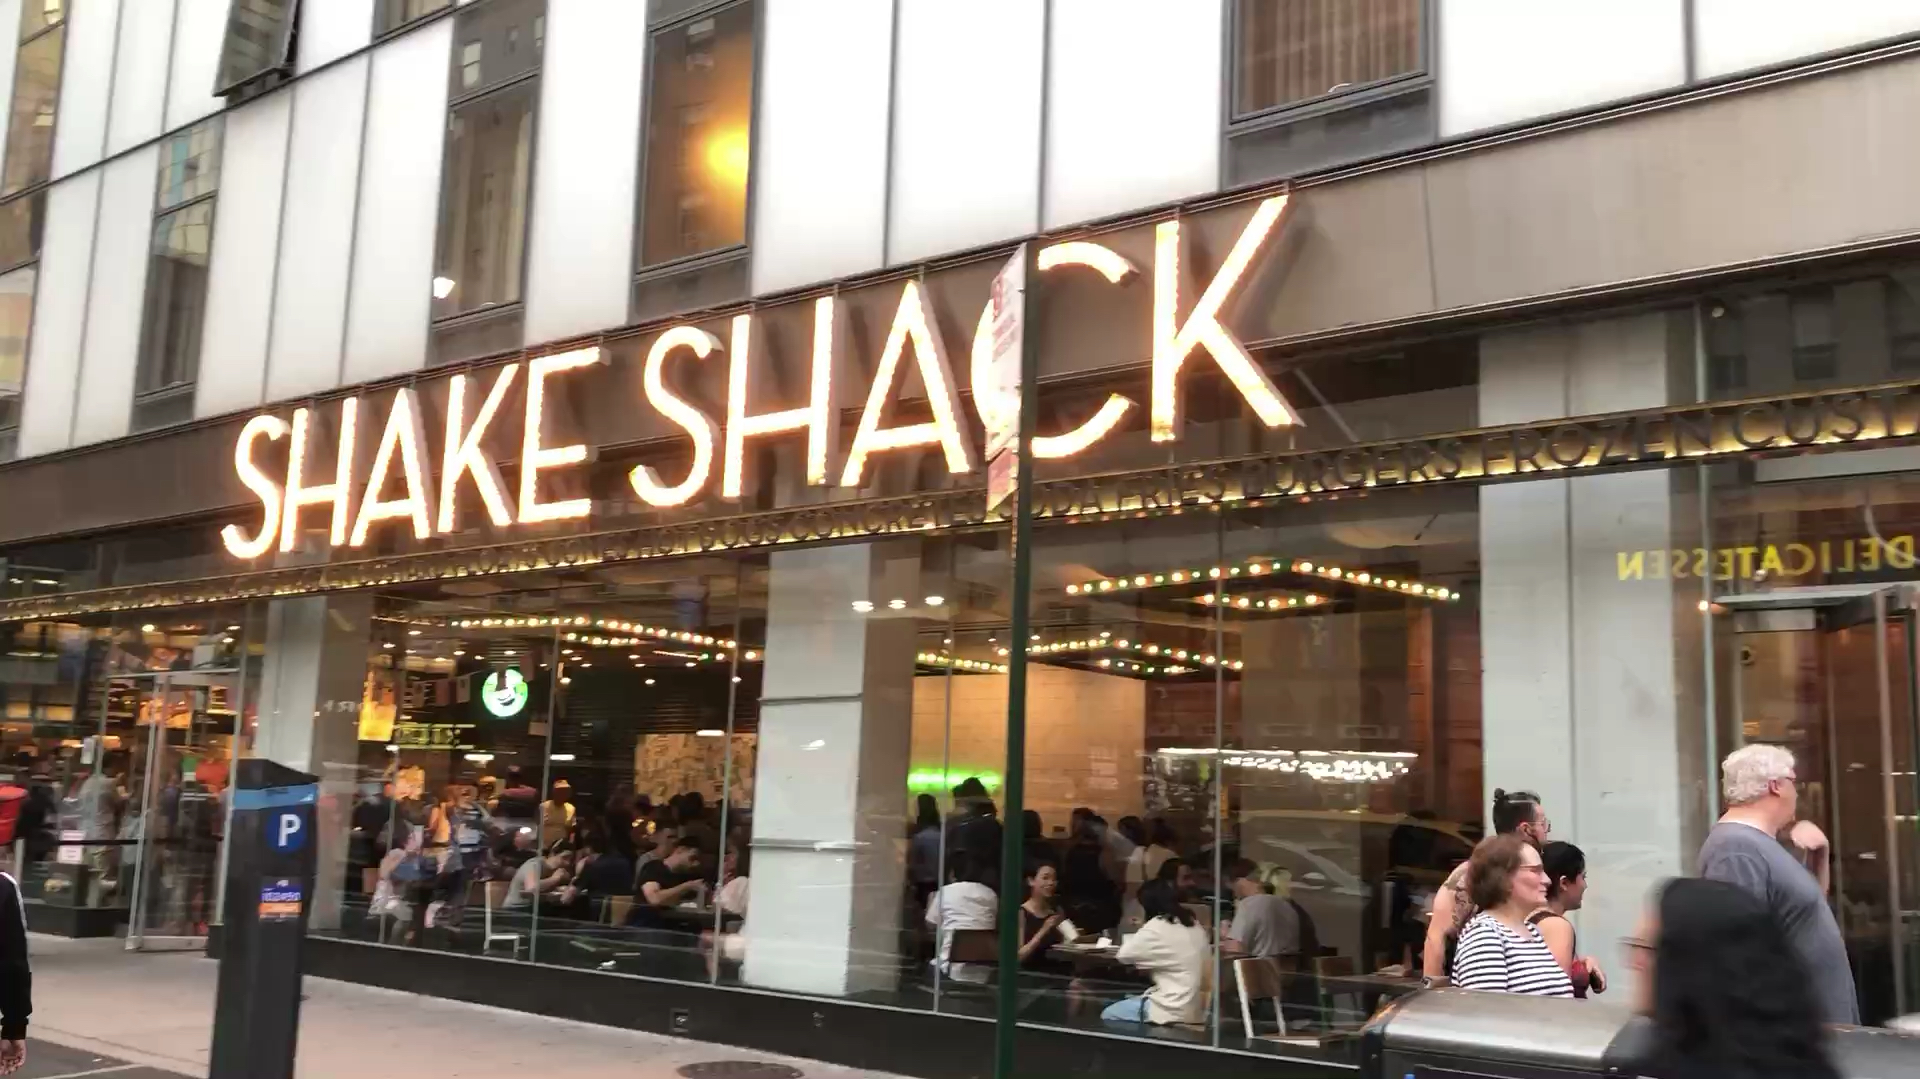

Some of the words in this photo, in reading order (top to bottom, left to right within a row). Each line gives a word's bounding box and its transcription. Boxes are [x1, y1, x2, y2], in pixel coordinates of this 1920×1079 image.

[221, 344, 607, 560] SHAKE
[630, 194, 1300, 507] SHACK
[1117, 462, 1225, 511] FRIES
[1244, 436, 1463, 500] BURGERS
[1481, 409, 1715, 476] FROZEN
[1730, 385, 1920, 450] CUST
[278, 813, 302, 847] P
